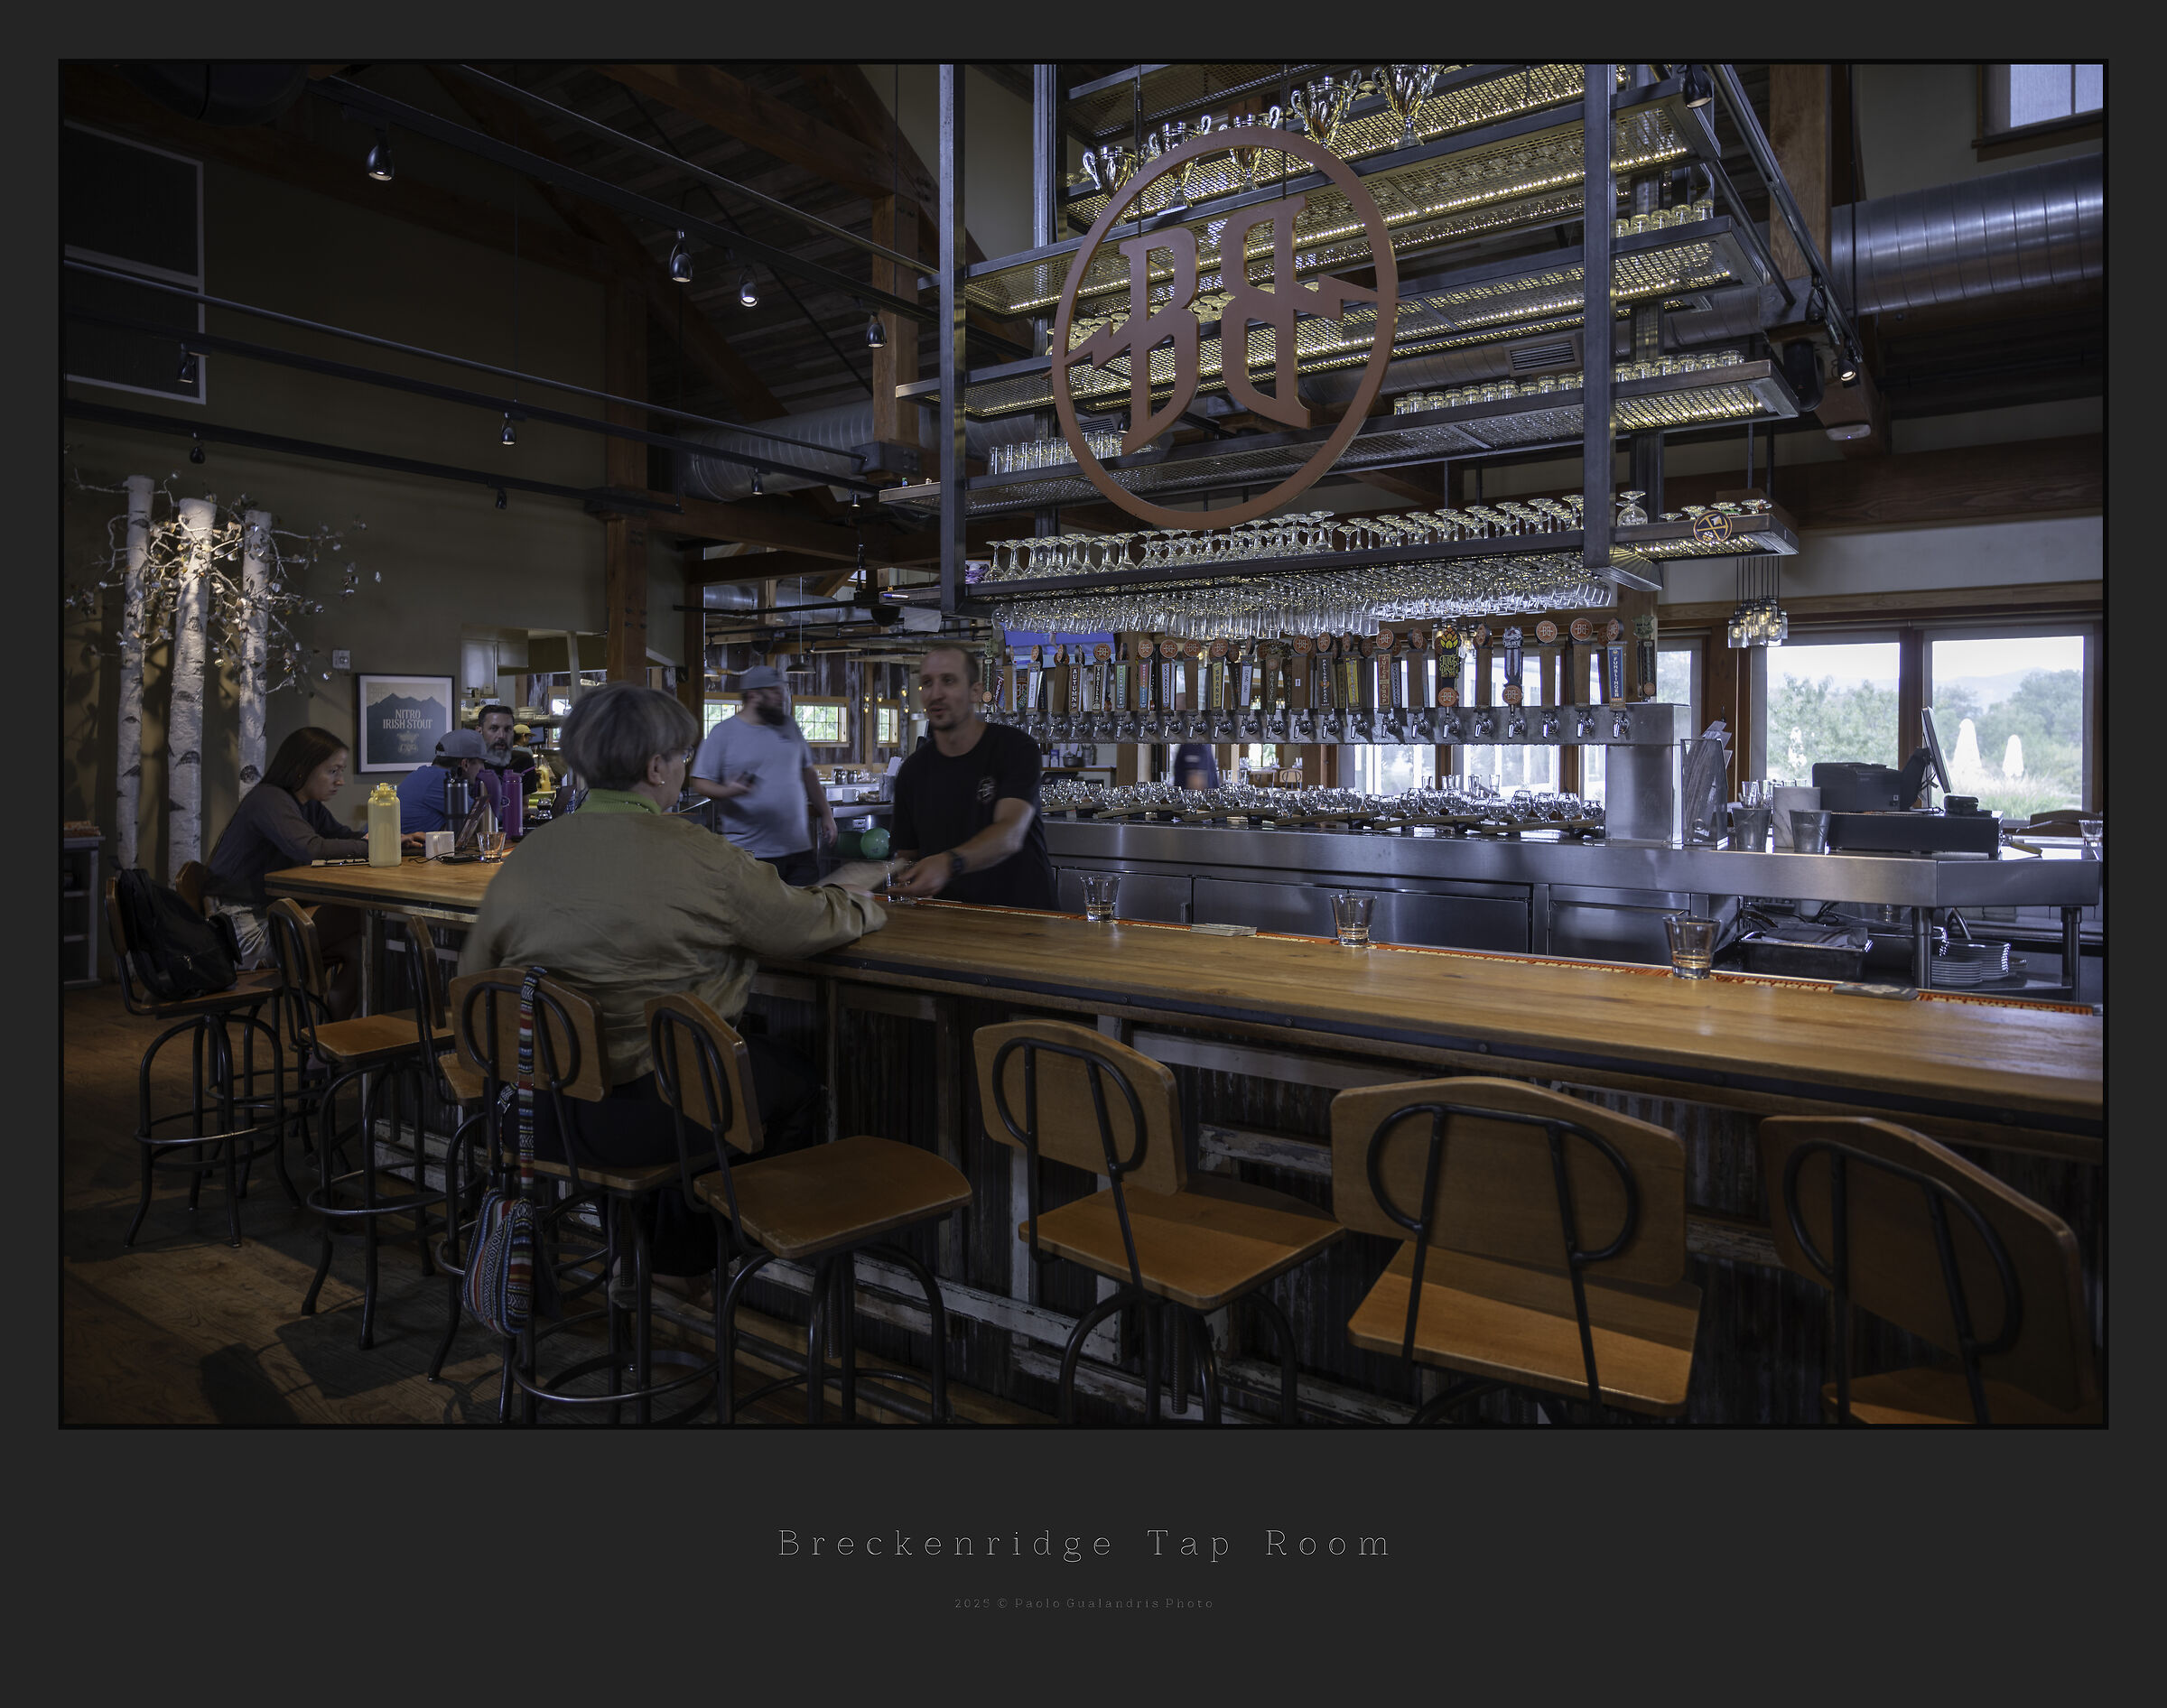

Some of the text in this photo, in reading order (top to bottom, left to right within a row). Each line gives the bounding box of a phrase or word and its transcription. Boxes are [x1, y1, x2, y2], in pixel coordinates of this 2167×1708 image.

[1439, 654, 1456, 666] JUICE
[395, 709, 421, 719] NITRO
[383, 719, 433, 729] IRISH STOUT
